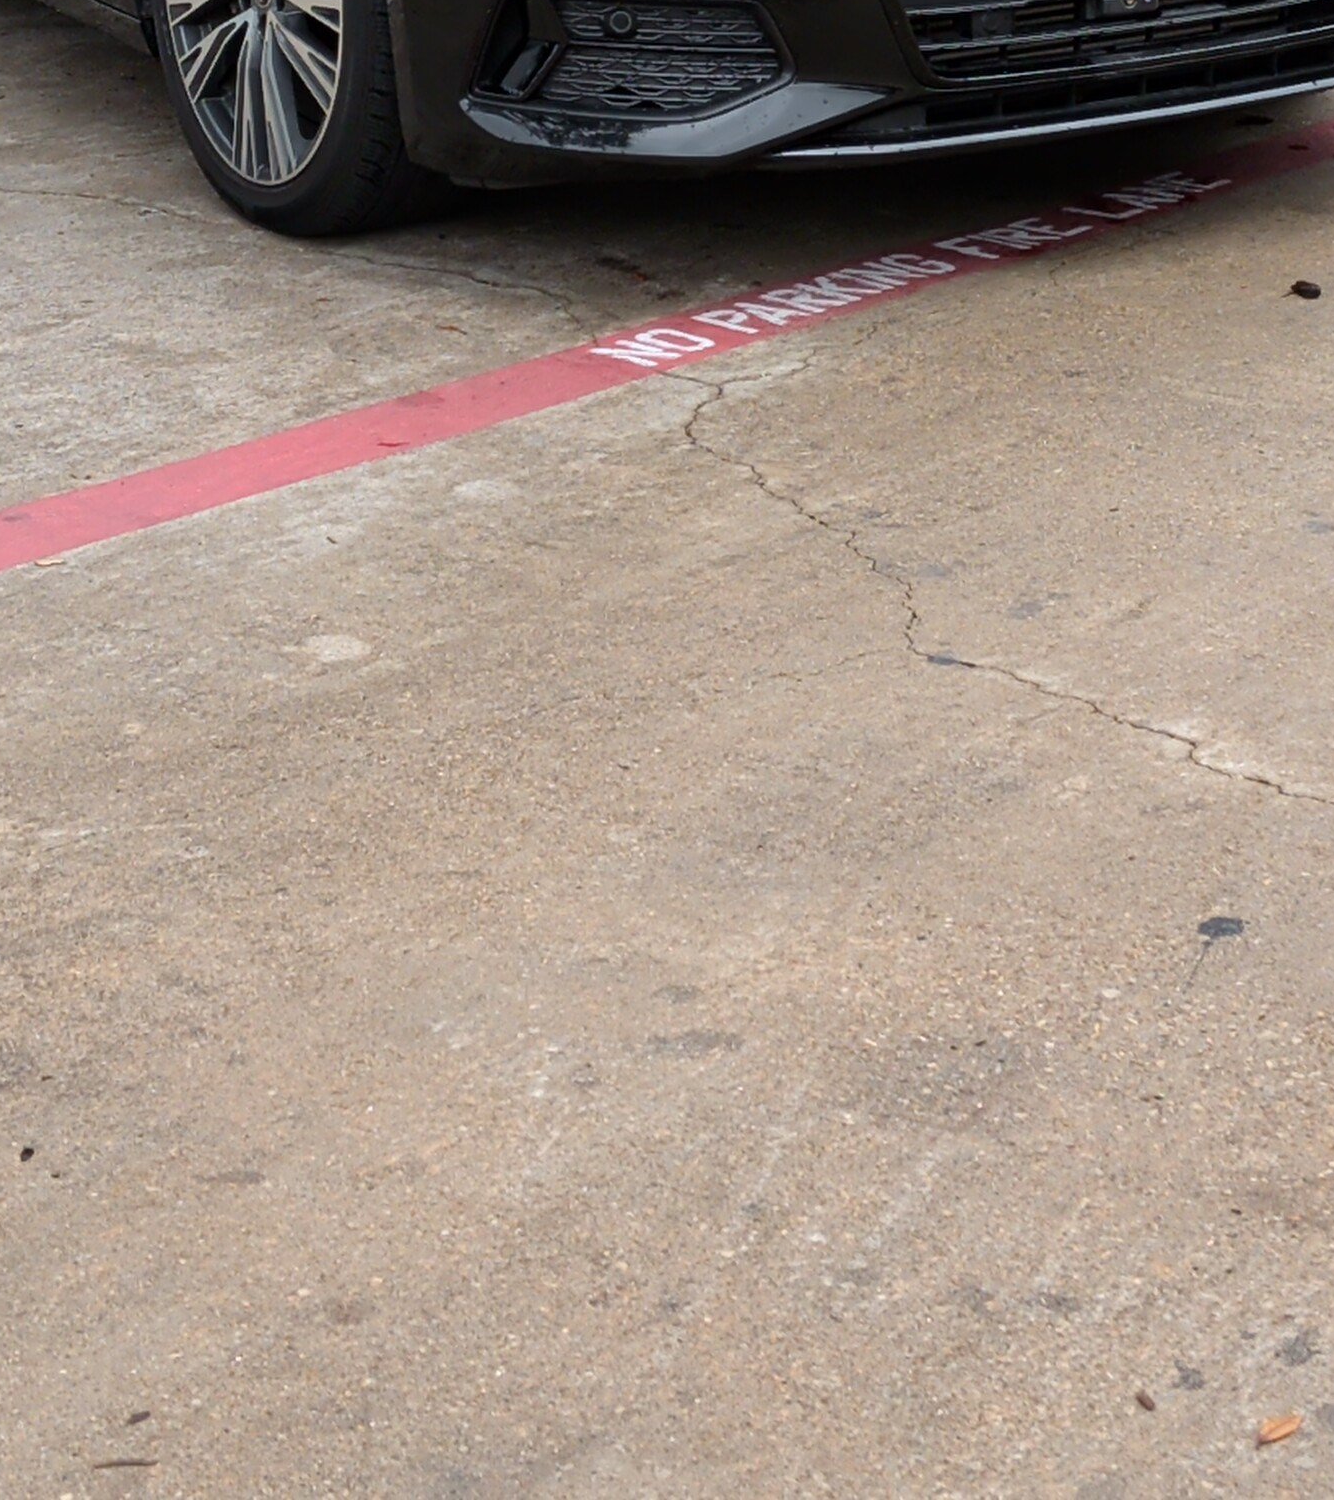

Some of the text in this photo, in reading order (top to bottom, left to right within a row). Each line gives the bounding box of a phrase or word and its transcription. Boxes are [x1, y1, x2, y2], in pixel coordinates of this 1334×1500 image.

[590, 171, 1232, 367] NO PARKING FIRE LANE
